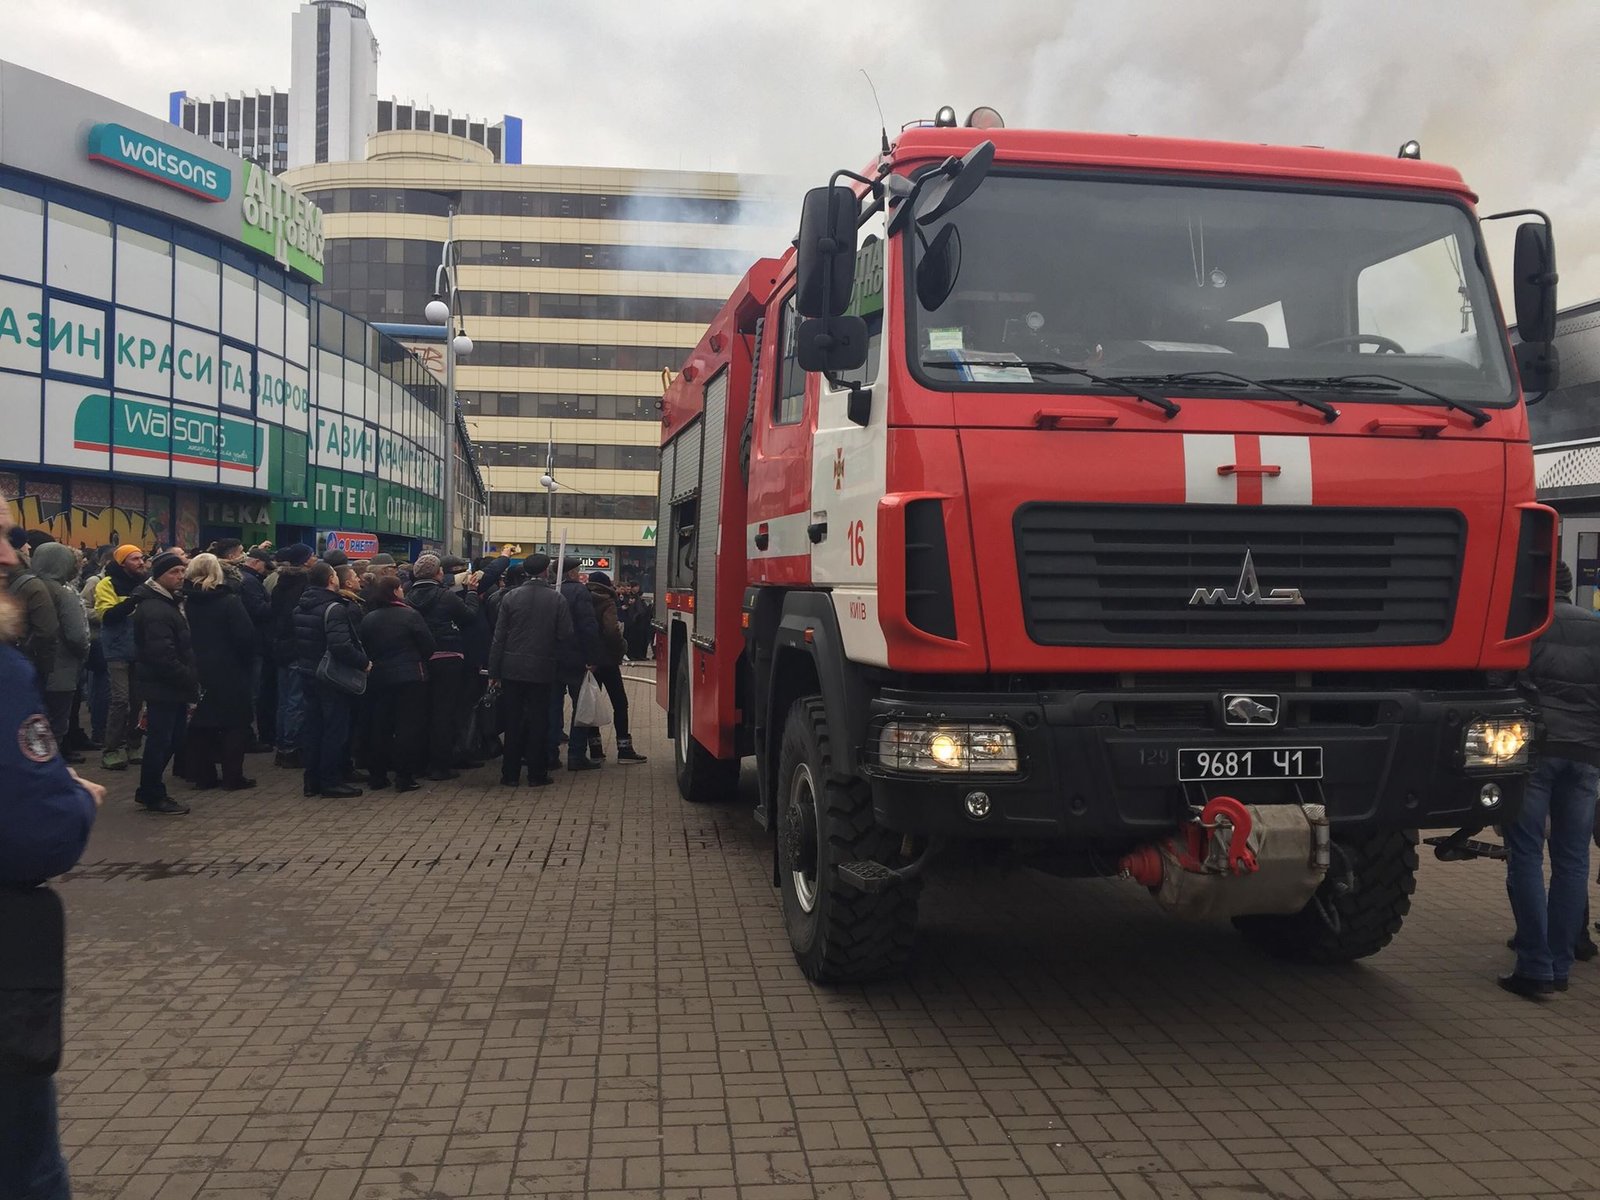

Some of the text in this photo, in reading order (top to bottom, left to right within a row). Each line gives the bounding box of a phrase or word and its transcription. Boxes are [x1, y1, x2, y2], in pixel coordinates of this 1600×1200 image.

[119, 135, 218, 190] watsons
[245, 163, 324, 236] АПТЕКА
[117, 333, 213, 385] КРАСИ
[847, 519, 865, 566] 16
[1196, 752, 1252, 777] 9681
